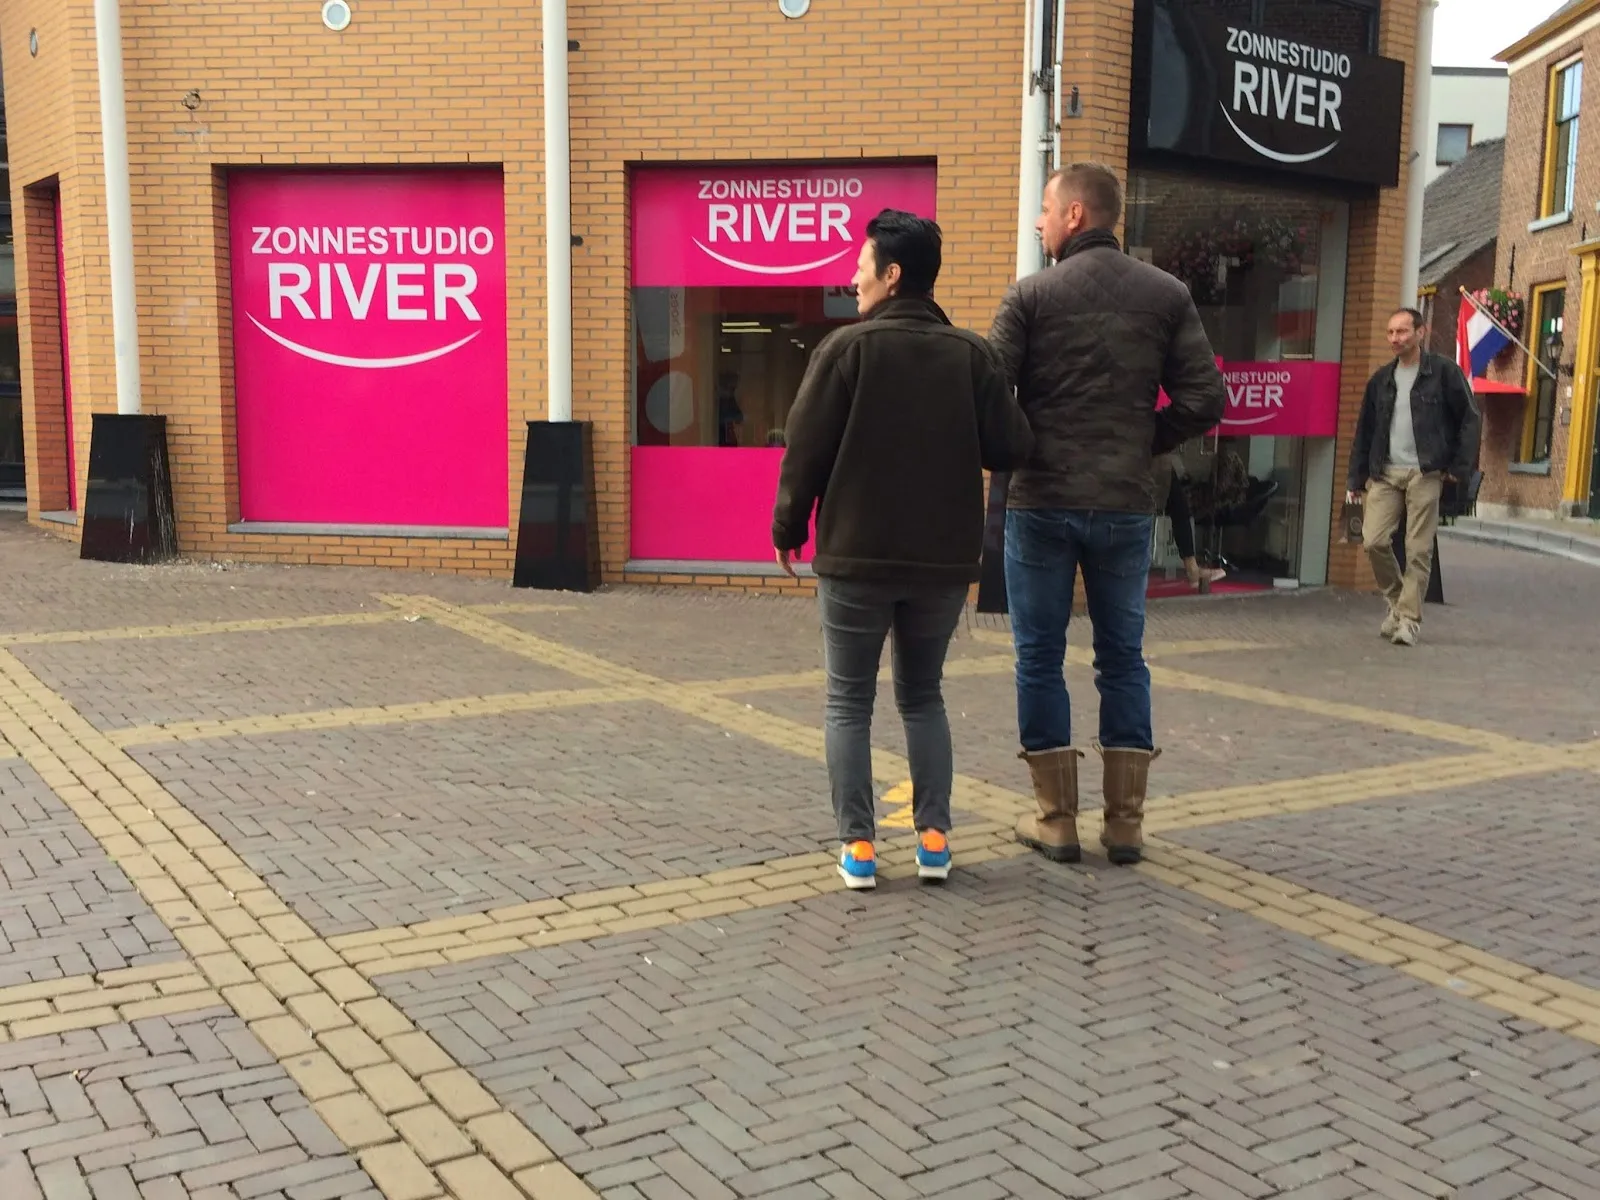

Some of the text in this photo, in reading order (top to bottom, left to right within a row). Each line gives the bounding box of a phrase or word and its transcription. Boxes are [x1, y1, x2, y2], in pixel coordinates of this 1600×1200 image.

[1226, 26, 1351, 78] ZONNESTUDIO
[1233, 60, 1342, 132] RIVER
[698, 179, 863, 199] ZONNESTUDIO
[707, 202, 853, 243] RIVER
[251, 226, 494, 255] ZONNESTUDIO
[267, 262, 482, 321] RIVER
[1222, 371, 1291, 384] NESTUDIO
[1226, 384, 1284, 408] VER
